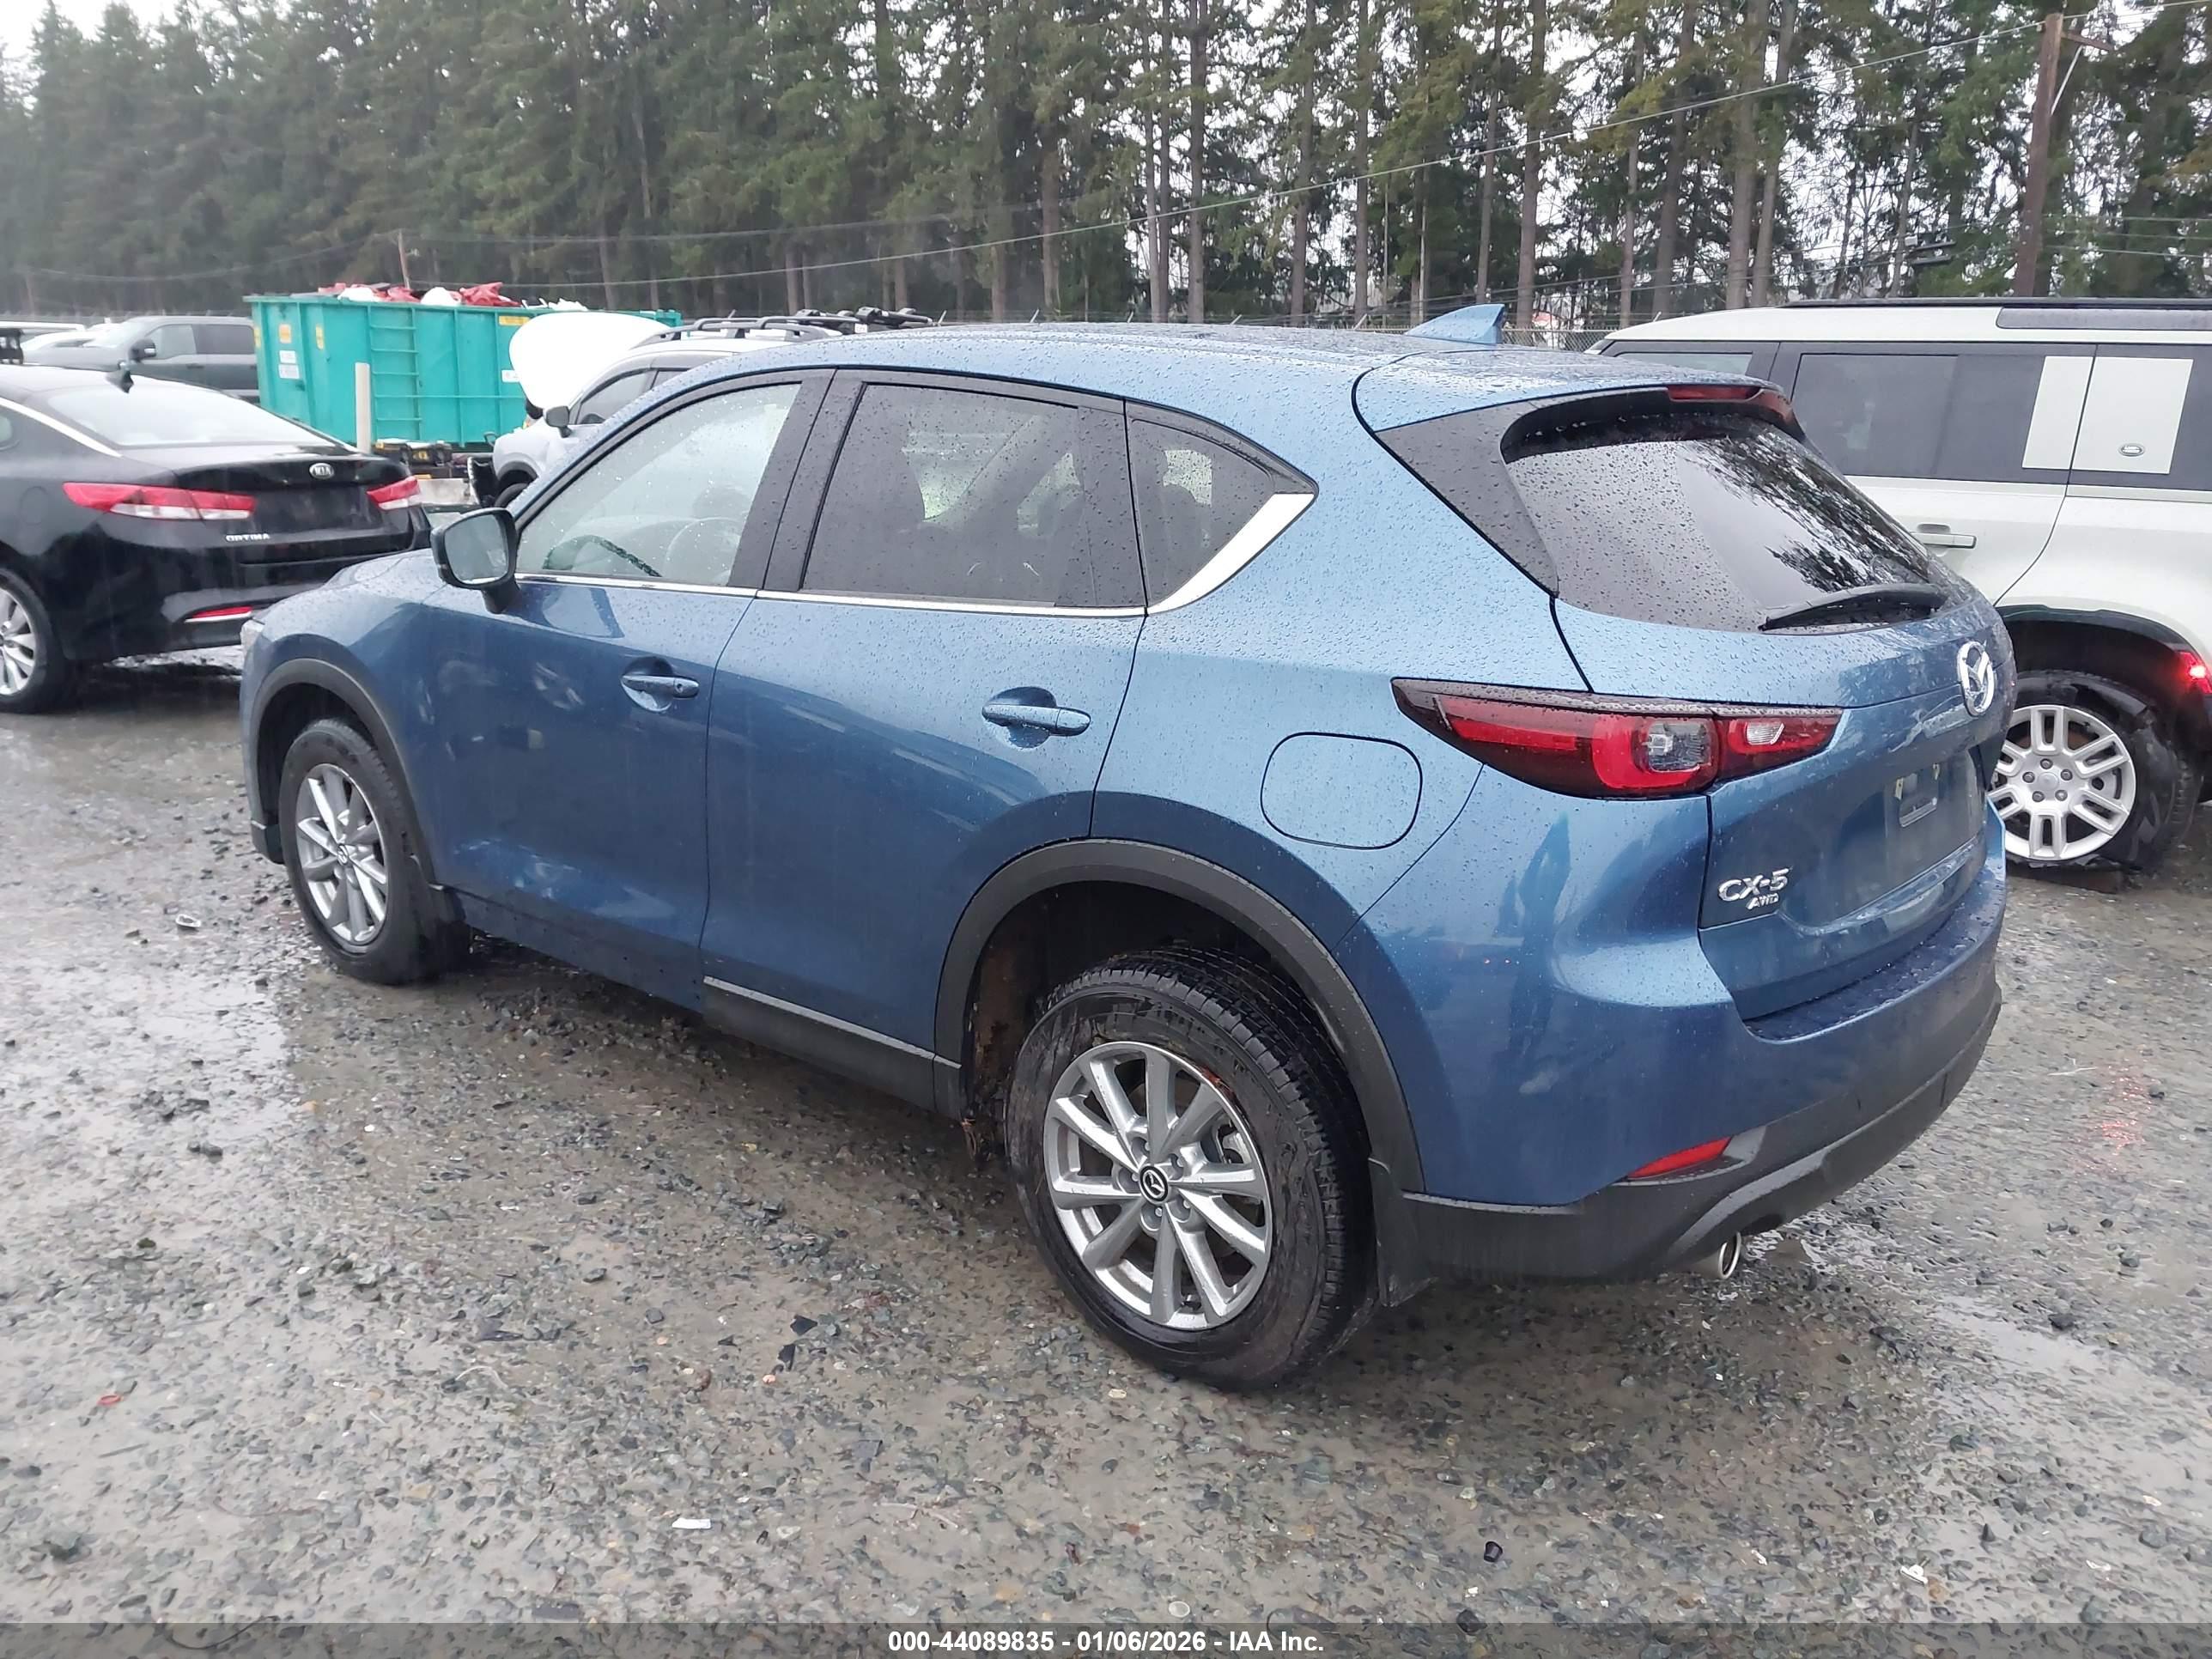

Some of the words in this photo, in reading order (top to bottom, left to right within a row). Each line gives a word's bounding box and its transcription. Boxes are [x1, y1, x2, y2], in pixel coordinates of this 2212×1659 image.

[225, 533, 270, 542] OPTIMA
[1718, 867, 1790, 902] CX-5
[1746, 892, 1779, 910] AWD
